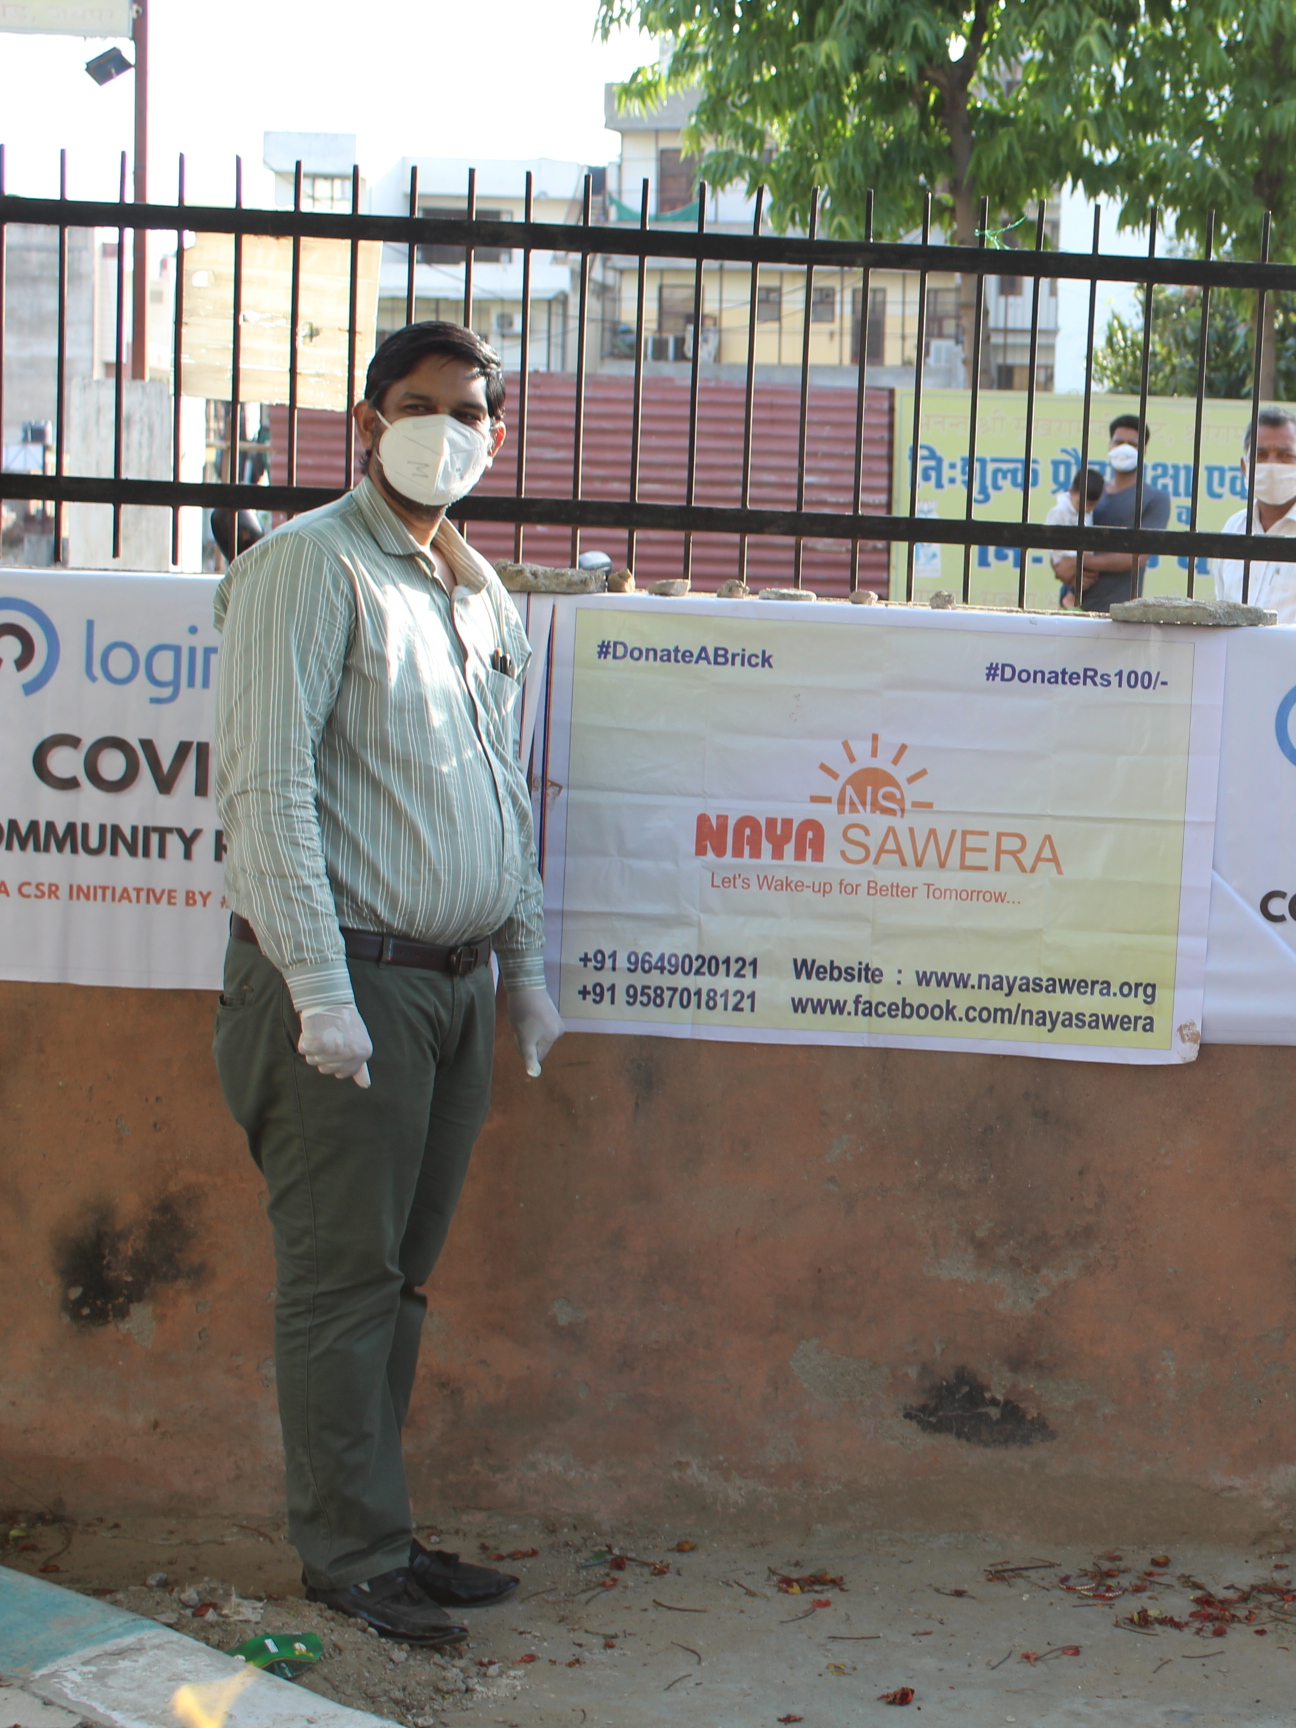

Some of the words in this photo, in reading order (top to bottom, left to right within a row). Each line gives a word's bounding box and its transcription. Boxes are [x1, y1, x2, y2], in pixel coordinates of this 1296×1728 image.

[596, 639, 774, 669] #DonateABrick
[984, 661, 1169, 691] #DonateRs100/-
[694, 812, 826, 863] NAYA
[839, 822, 1064, 876] SAWERA
[17, 881, 61, 900] CSR
[68, 884, 178, 906] INITIATIVE
[185, 889, 212, 908] BY
[710, 871, 751, 891] Let's
[756, 874, 833, 897] Wake-up
[838, 877, 862, 896] for
[866, 880, 918, 900] Better
[923, 883, 1022, 905] Tomorrow...
[578, 949, 618, 973] +91
[626, 951, 759, 979] 9649020121
[792, 957, 884, 985] Website
[914, 969, 1157, 1005] www.nayasawera.org
[577, 982, 616, 1006] +91
[624, 984, 757, 1013] 9587018121
[790, 993, 1155, 1034] www.facebook.com/nayasawera
